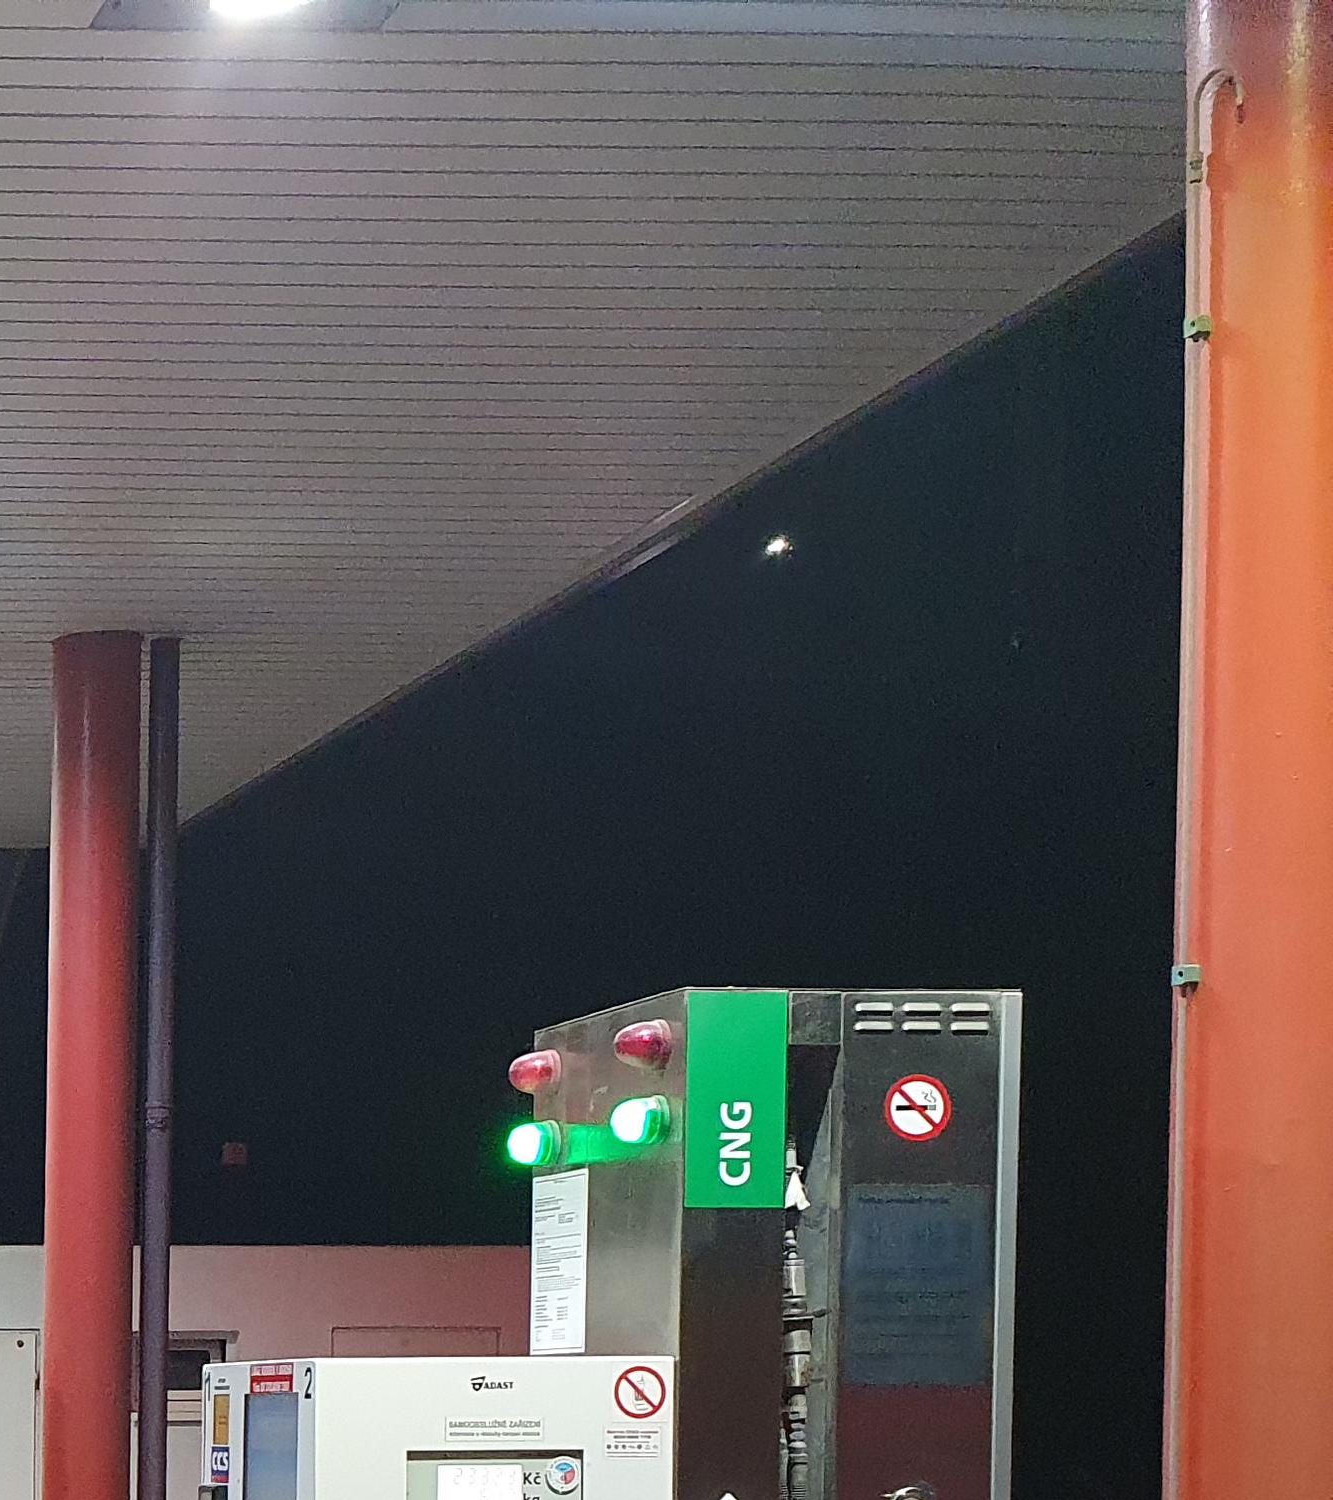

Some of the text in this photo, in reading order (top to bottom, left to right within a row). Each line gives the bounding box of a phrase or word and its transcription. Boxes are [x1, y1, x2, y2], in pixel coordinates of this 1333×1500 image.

[719, 1101, 752, 1187] CNG
[304, 1367, 312, 1400] 2
[483, 1381, 514, 1390] ADAST
[212, 1452, 229, 1472] CCS
[523, 1472, 541, 1486] Kč
